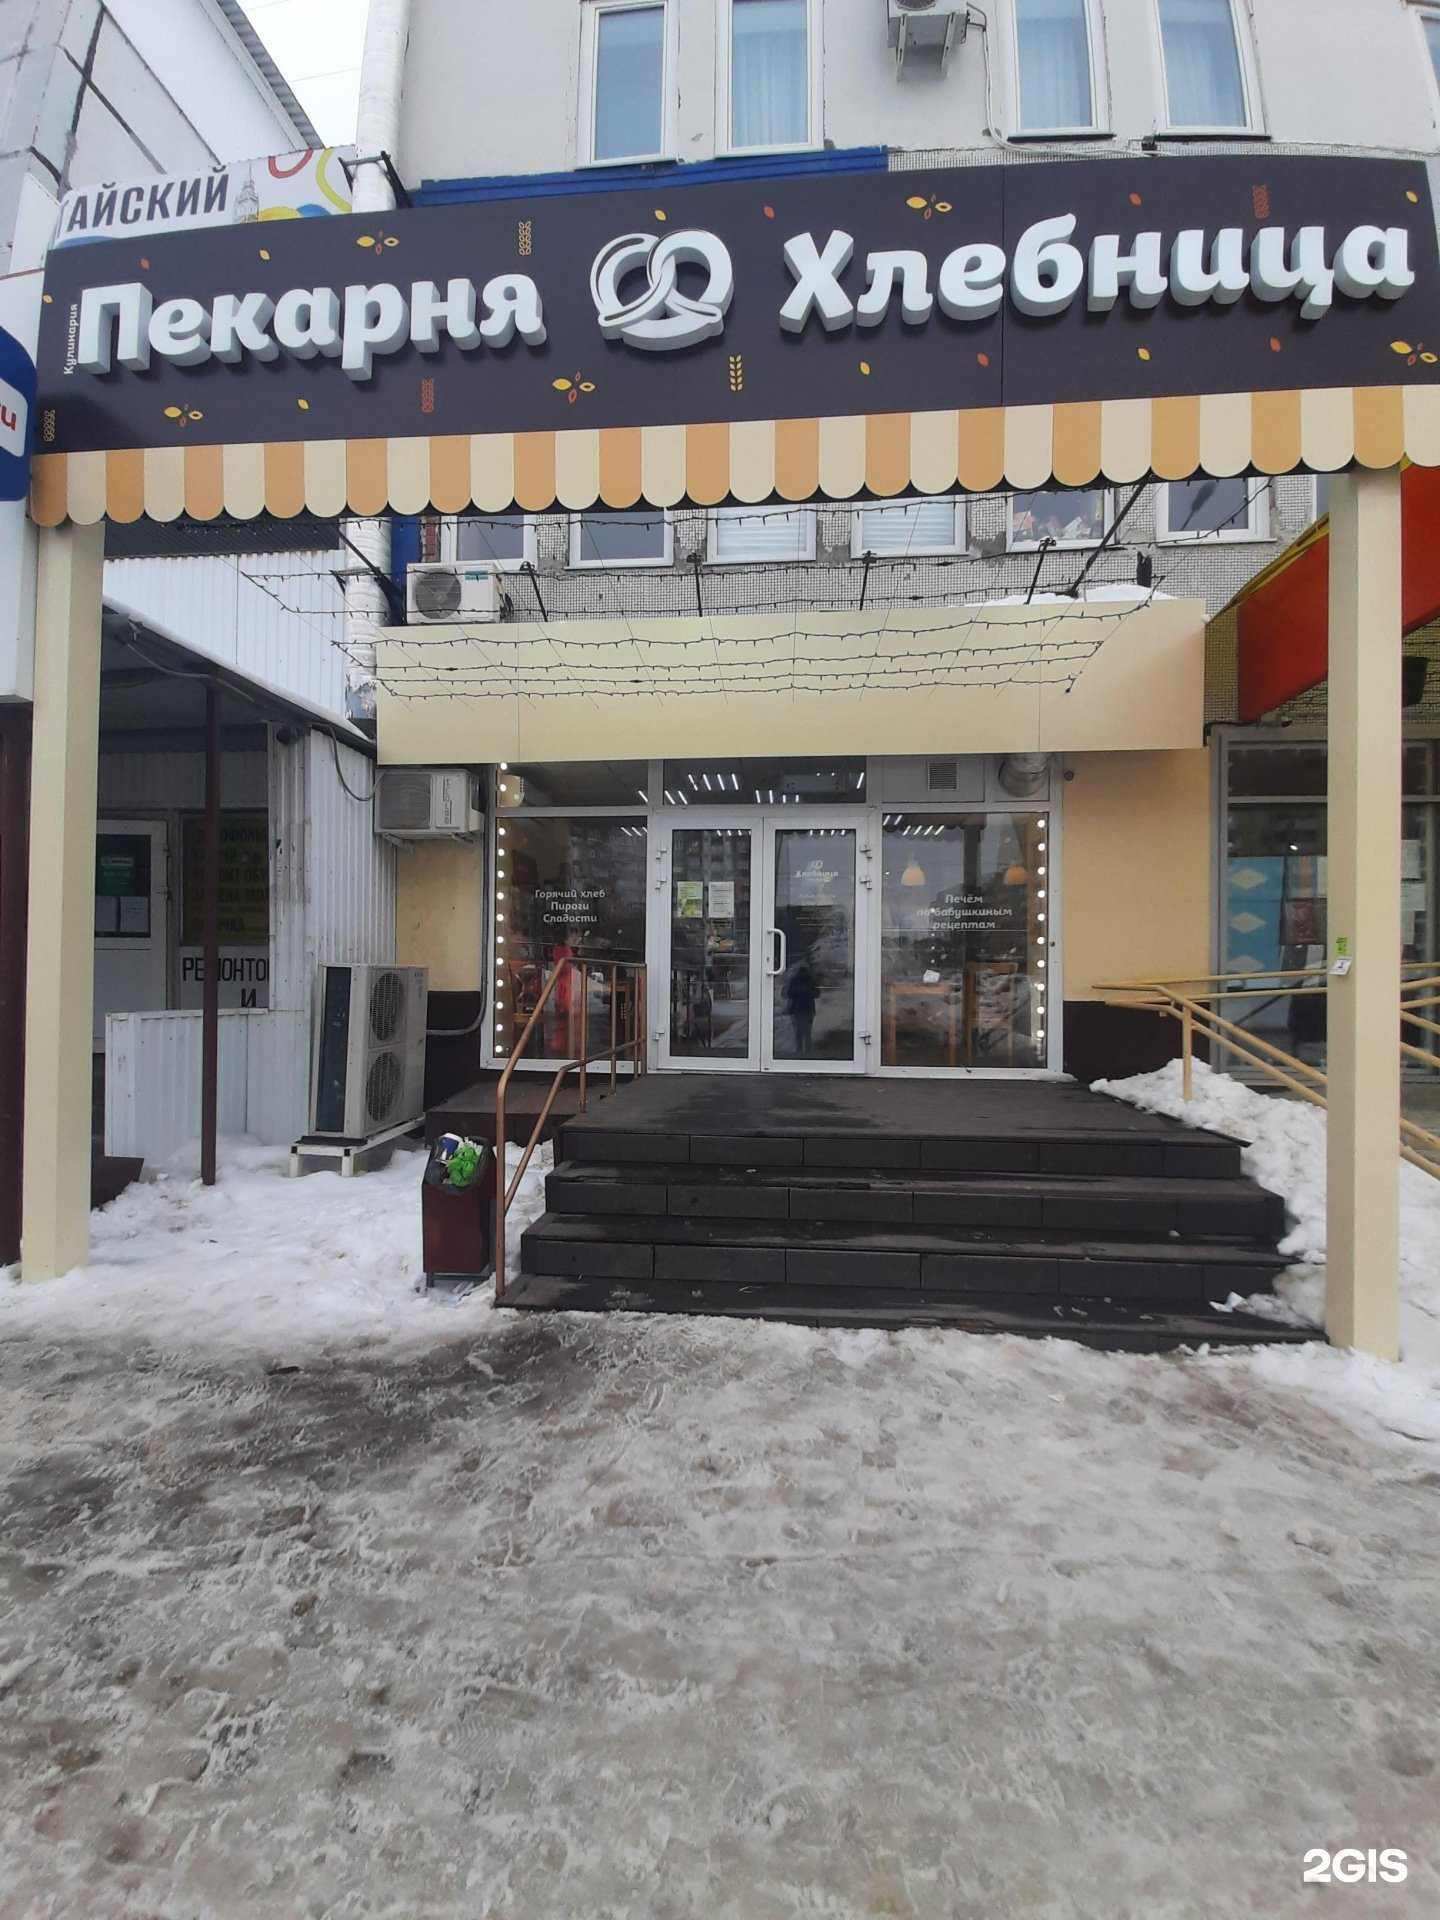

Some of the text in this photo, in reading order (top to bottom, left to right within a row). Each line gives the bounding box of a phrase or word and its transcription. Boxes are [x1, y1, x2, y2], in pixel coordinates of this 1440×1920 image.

[77, 212, 1415, 381] Пекарня Хлебница
[63, 303, 79, 376] Кулинария
[535, 889, 606, 900] Горячий хлеб
[945, 894, 983, 904] Печём
[550, 901, 590, 913] Пироги
[935, 907, 1013, 919] бабушкиным
[543, 913, 598, 923] Сладости
[932, 921, 996, 931] рецептам
[182, 957, 270, 982] РЕОНТО
